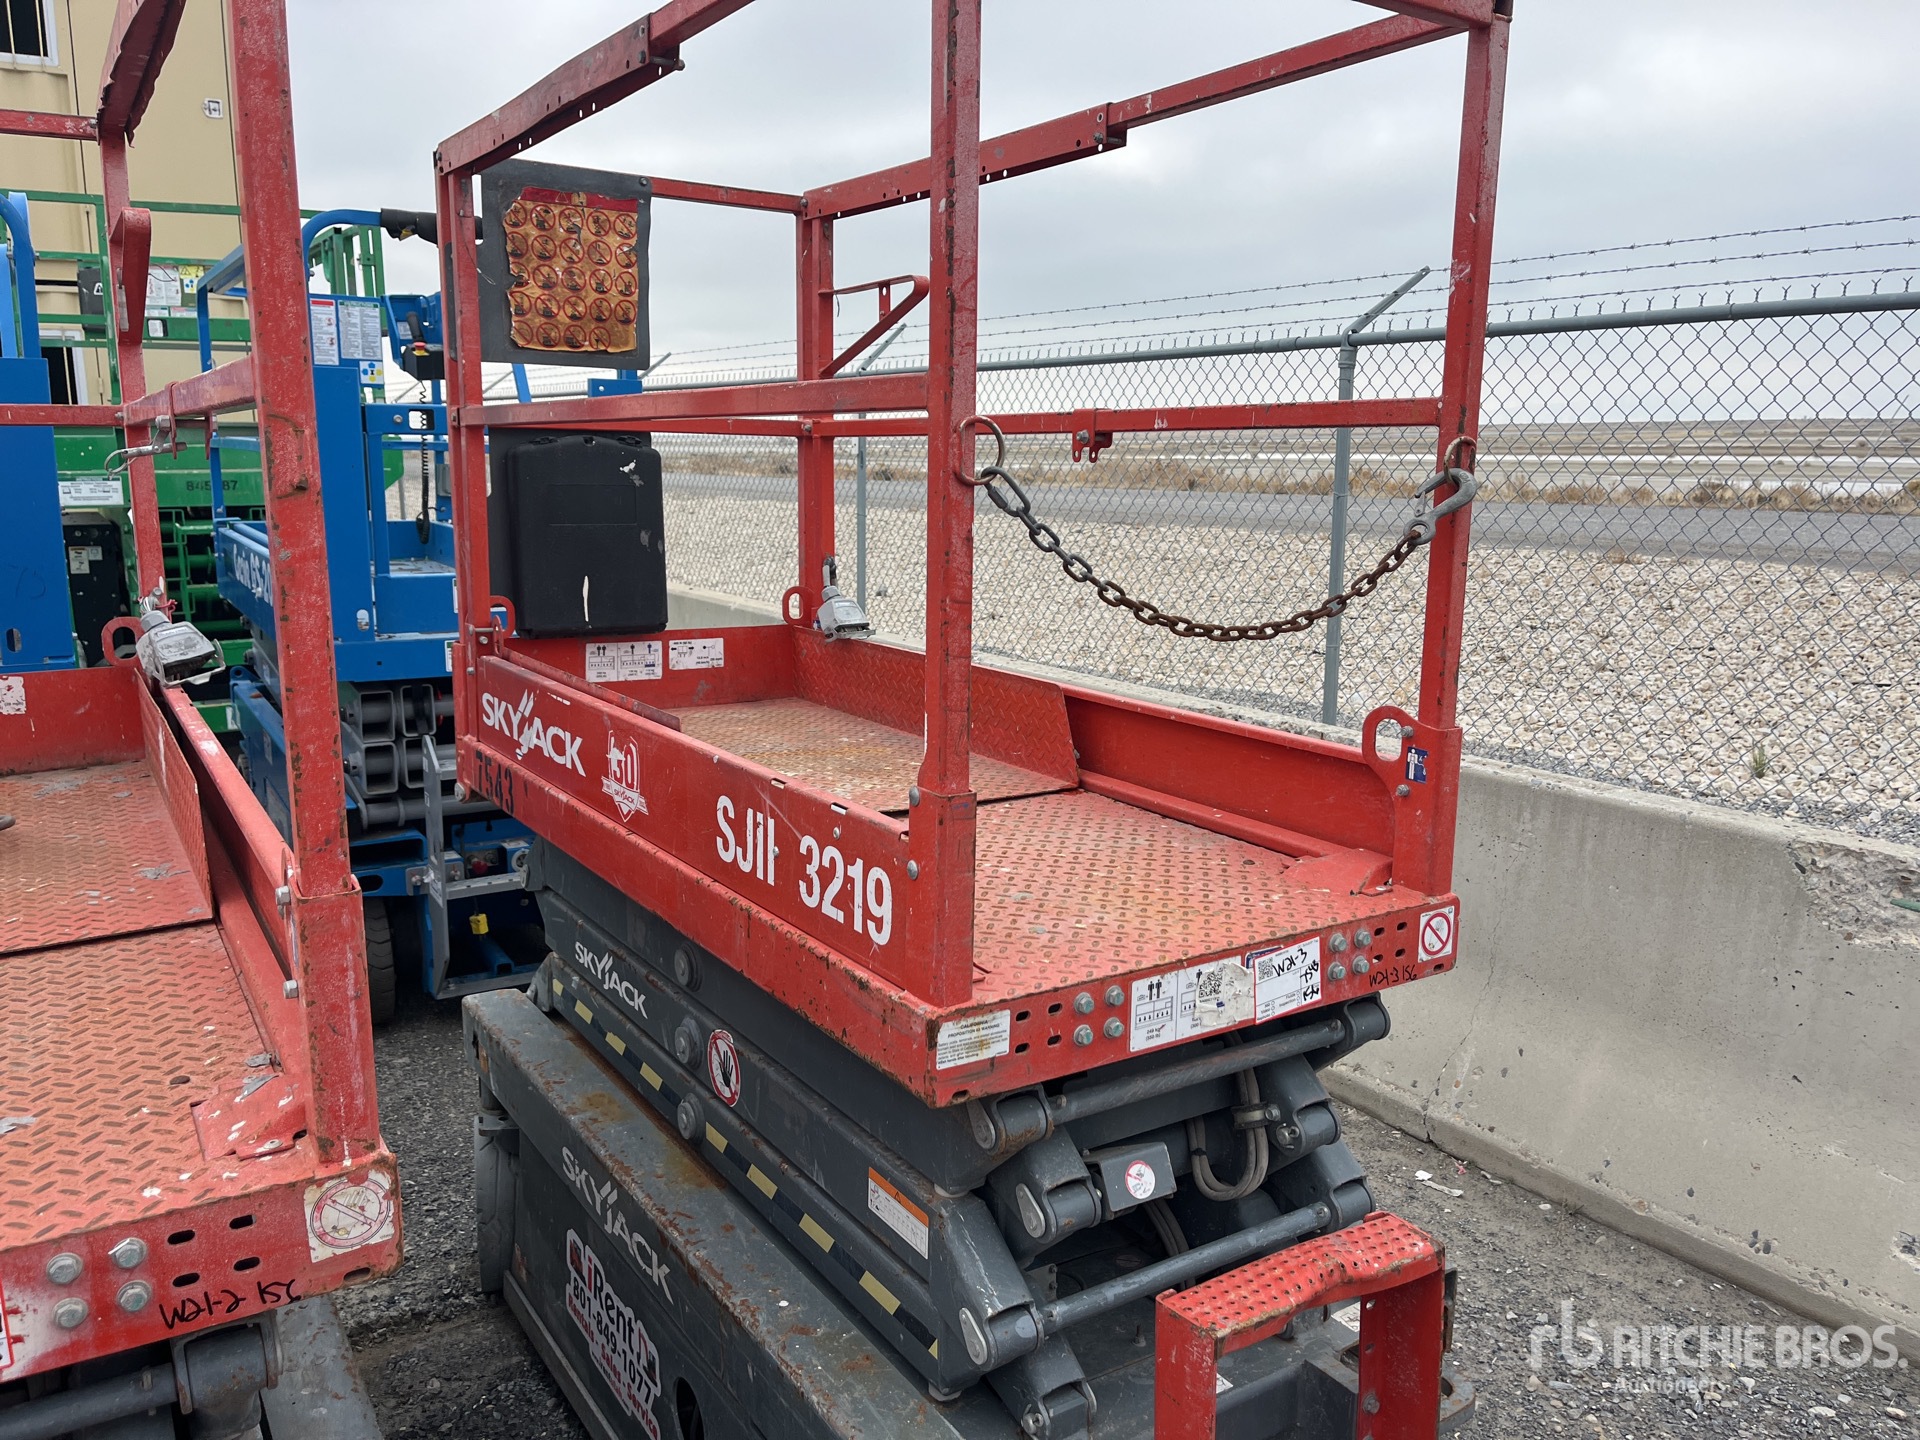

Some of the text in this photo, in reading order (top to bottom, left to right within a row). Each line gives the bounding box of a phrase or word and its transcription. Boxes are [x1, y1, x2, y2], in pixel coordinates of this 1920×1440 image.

[186, 480, 238, 491] 84587
[482, 689, 587, 778] SKYJACK
[799, 835, 892, 945] 3219
[575, 941, 648, 1019] SKYJACK
[1272, 948, 1308, 977] W21-3
[947, 1029, 976, 1039] PROPOSITION
[960, 1020, 988, 1030] CALIFORNIA
[562, 1146, 674, 1306] SKYJACK
[573, 1276, 652, 1405] 801-849-1077
[587, 1254, 634, 1355] iRent
[569, 1293, 595, 1344] Rentals
[601, 1343, 622, 1384] Sales
[627, 1382, 658, 1440] Service
